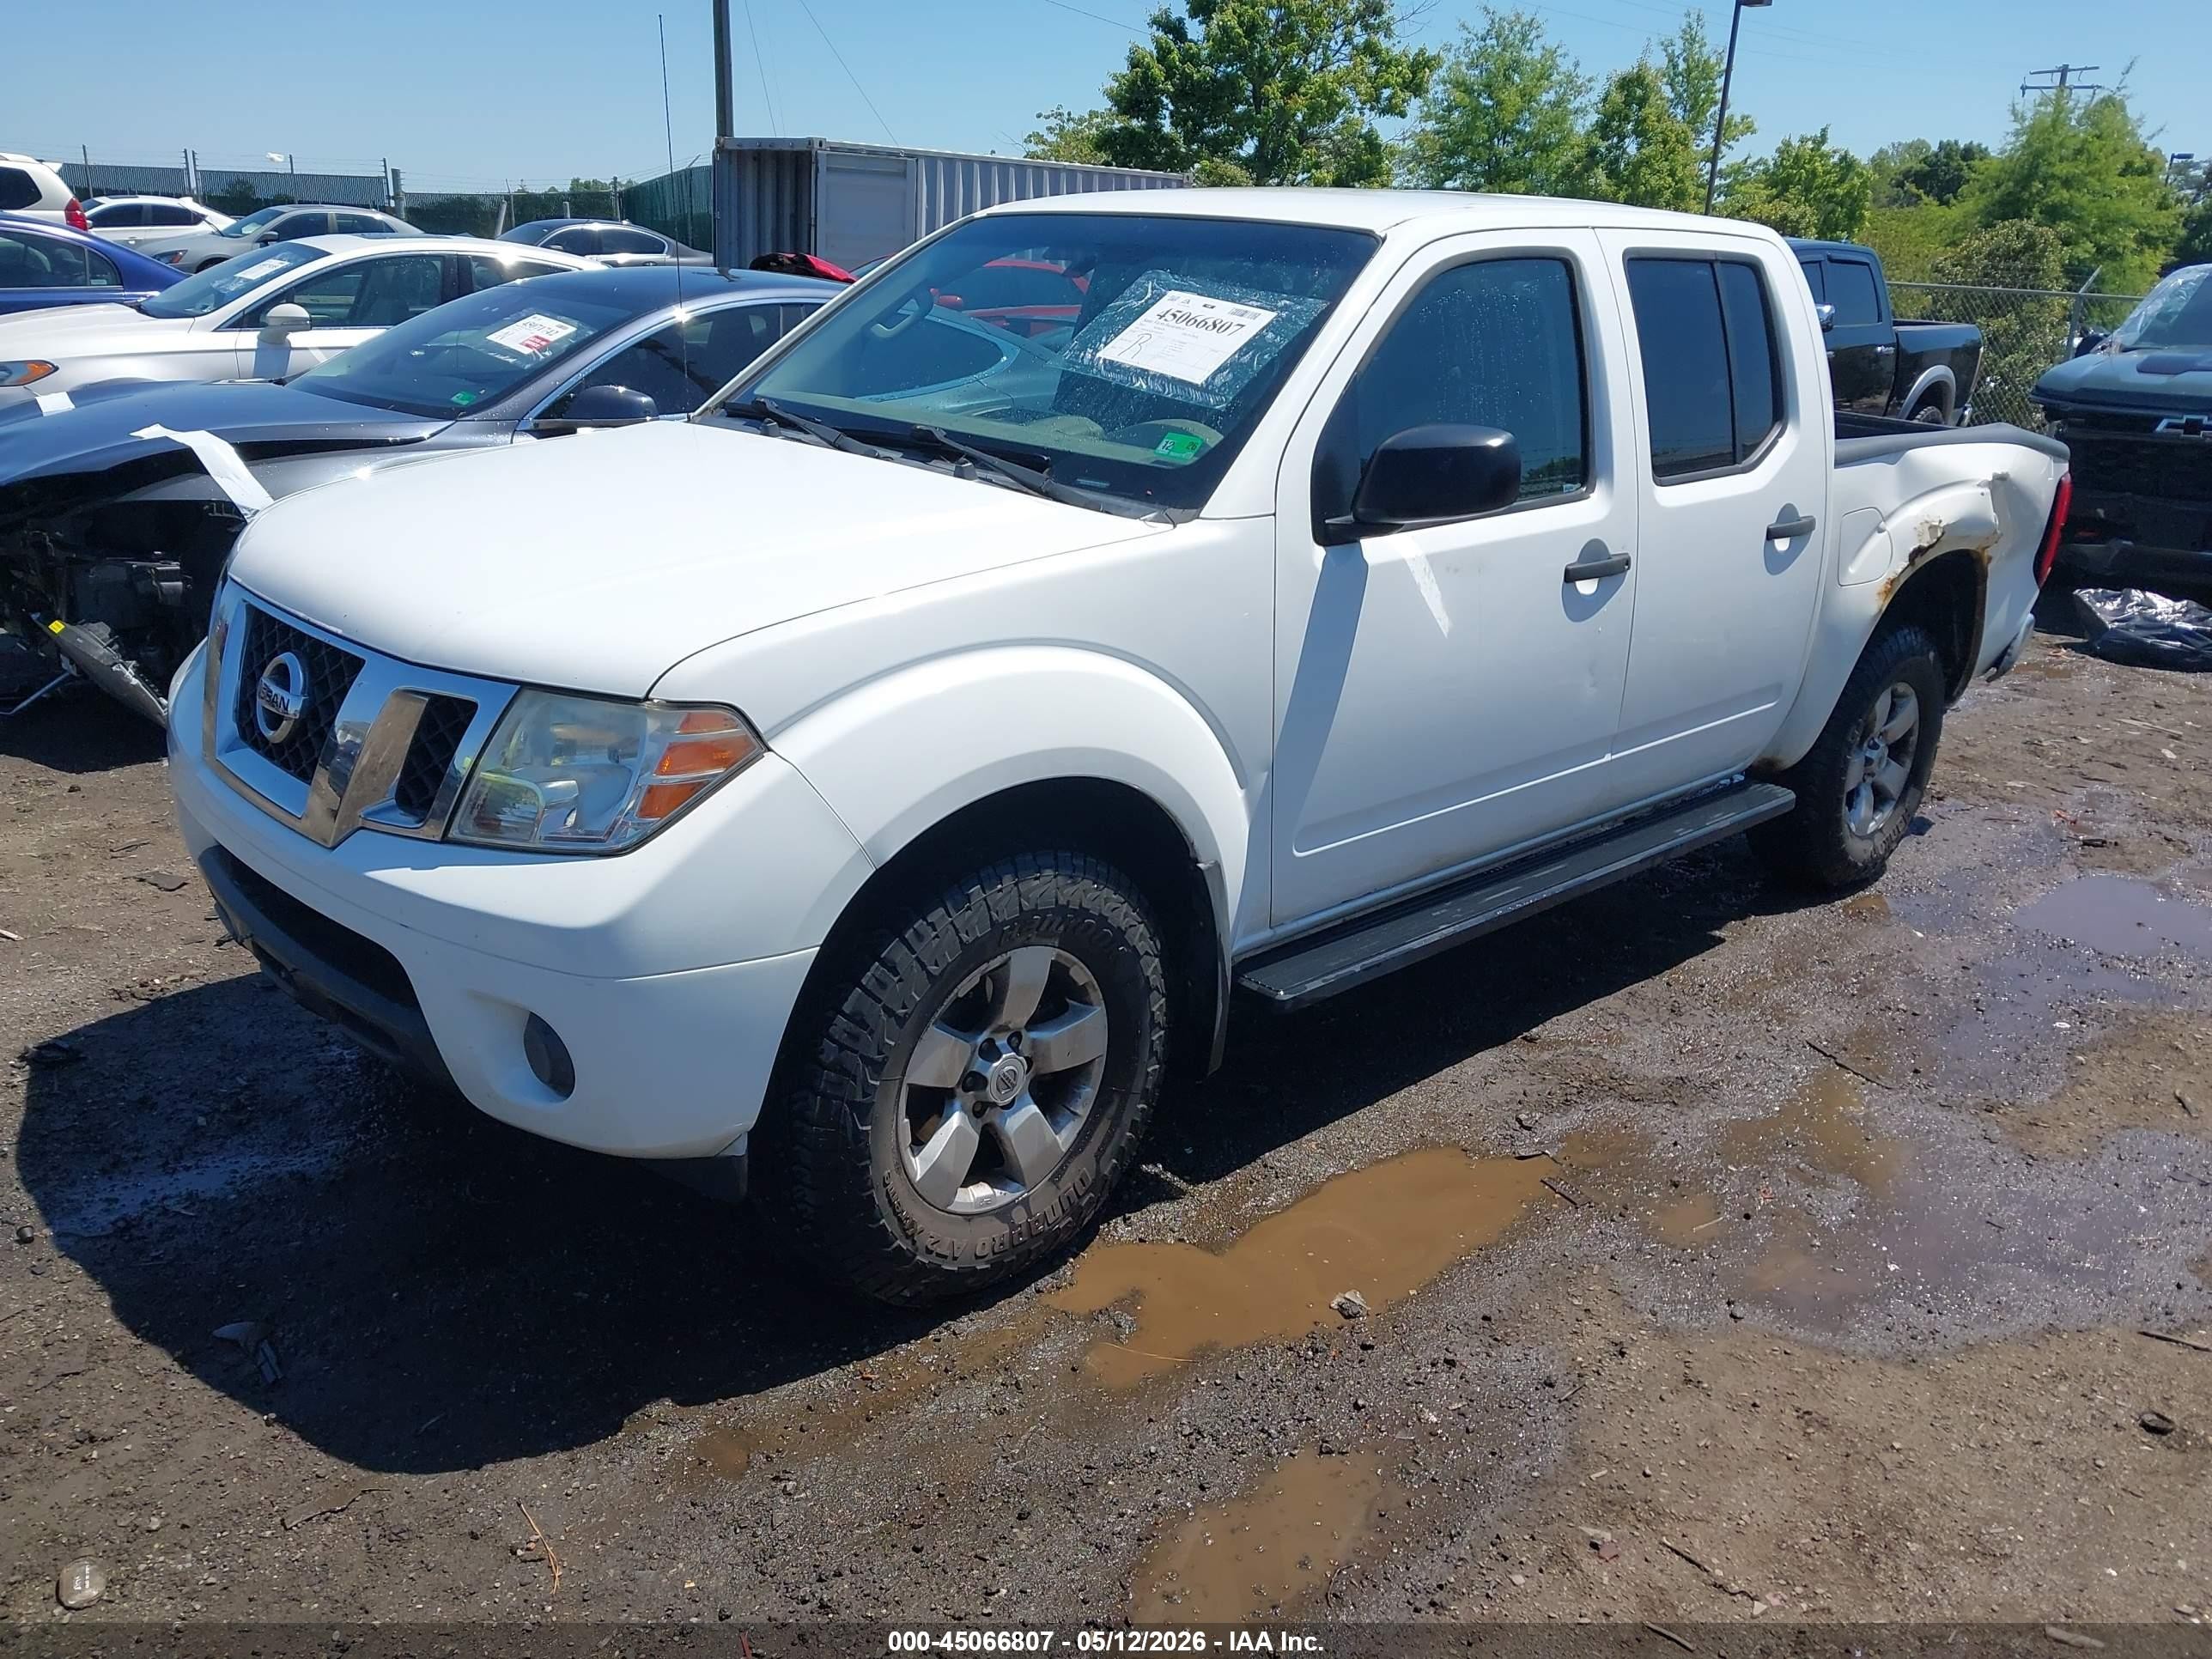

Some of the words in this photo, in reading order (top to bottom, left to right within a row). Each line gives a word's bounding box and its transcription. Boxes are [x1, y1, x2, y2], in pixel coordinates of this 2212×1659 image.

[1156, 308, 1246, 337] 45066807
[1118, 332, 1152, 359] R
[1162, 440, 1176, 451] 12
